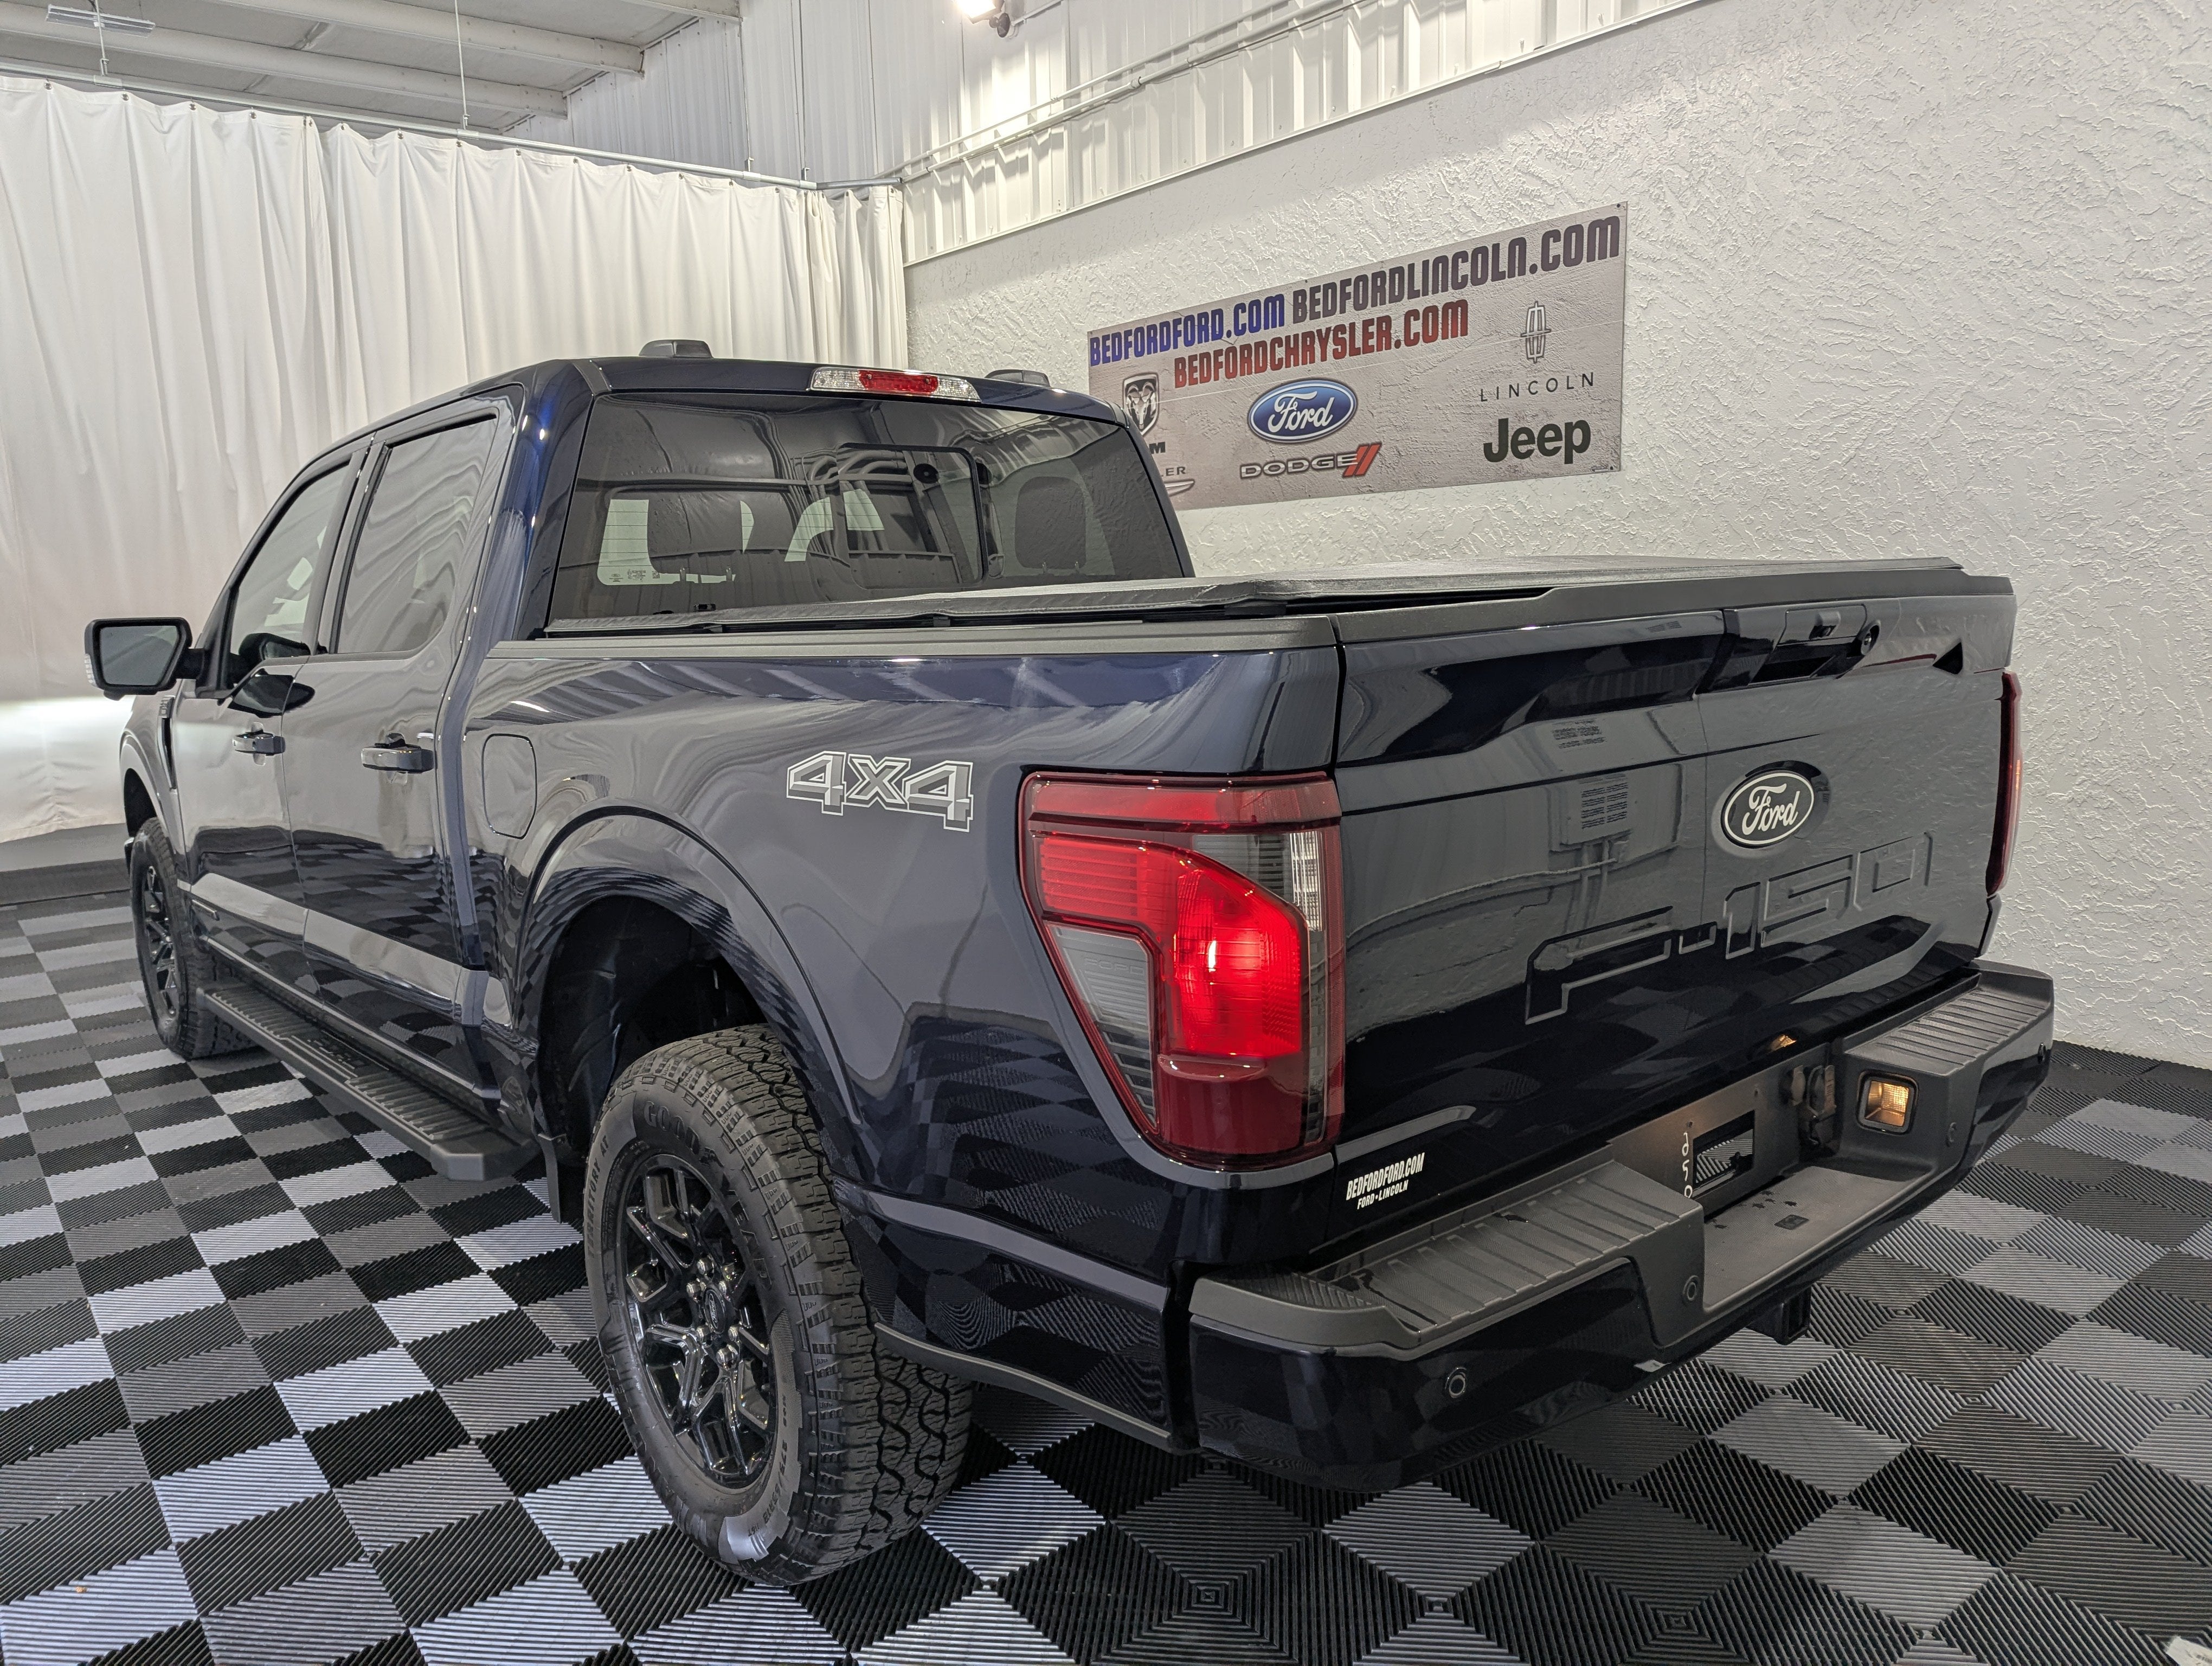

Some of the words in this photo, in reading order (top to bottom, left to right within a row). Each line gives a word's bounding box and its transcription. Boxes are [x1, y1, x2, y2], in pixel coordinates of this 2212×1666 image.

[1090, 293, 1285, 367] BEDFORDFORD.COM
[1293, 216, 1621, 324] BEDFORDLINCOLN.COM
[1174, 298, 1469, 388] BEDFORDCHRYSLER.COM
[1268, 390, 1335, 433] Ford
[1480, 372, 1594, 402] LINCOLN
[1240, 452, 1359, 478] DODGE
[1483, 418, 1591, 465] Jeep
[1741, 783, 1801, 835] Ford
[1525, 831, 1934, 1025] F-150
[1346, 1152, 1425, 1201] BEDFORDFORD.COM
